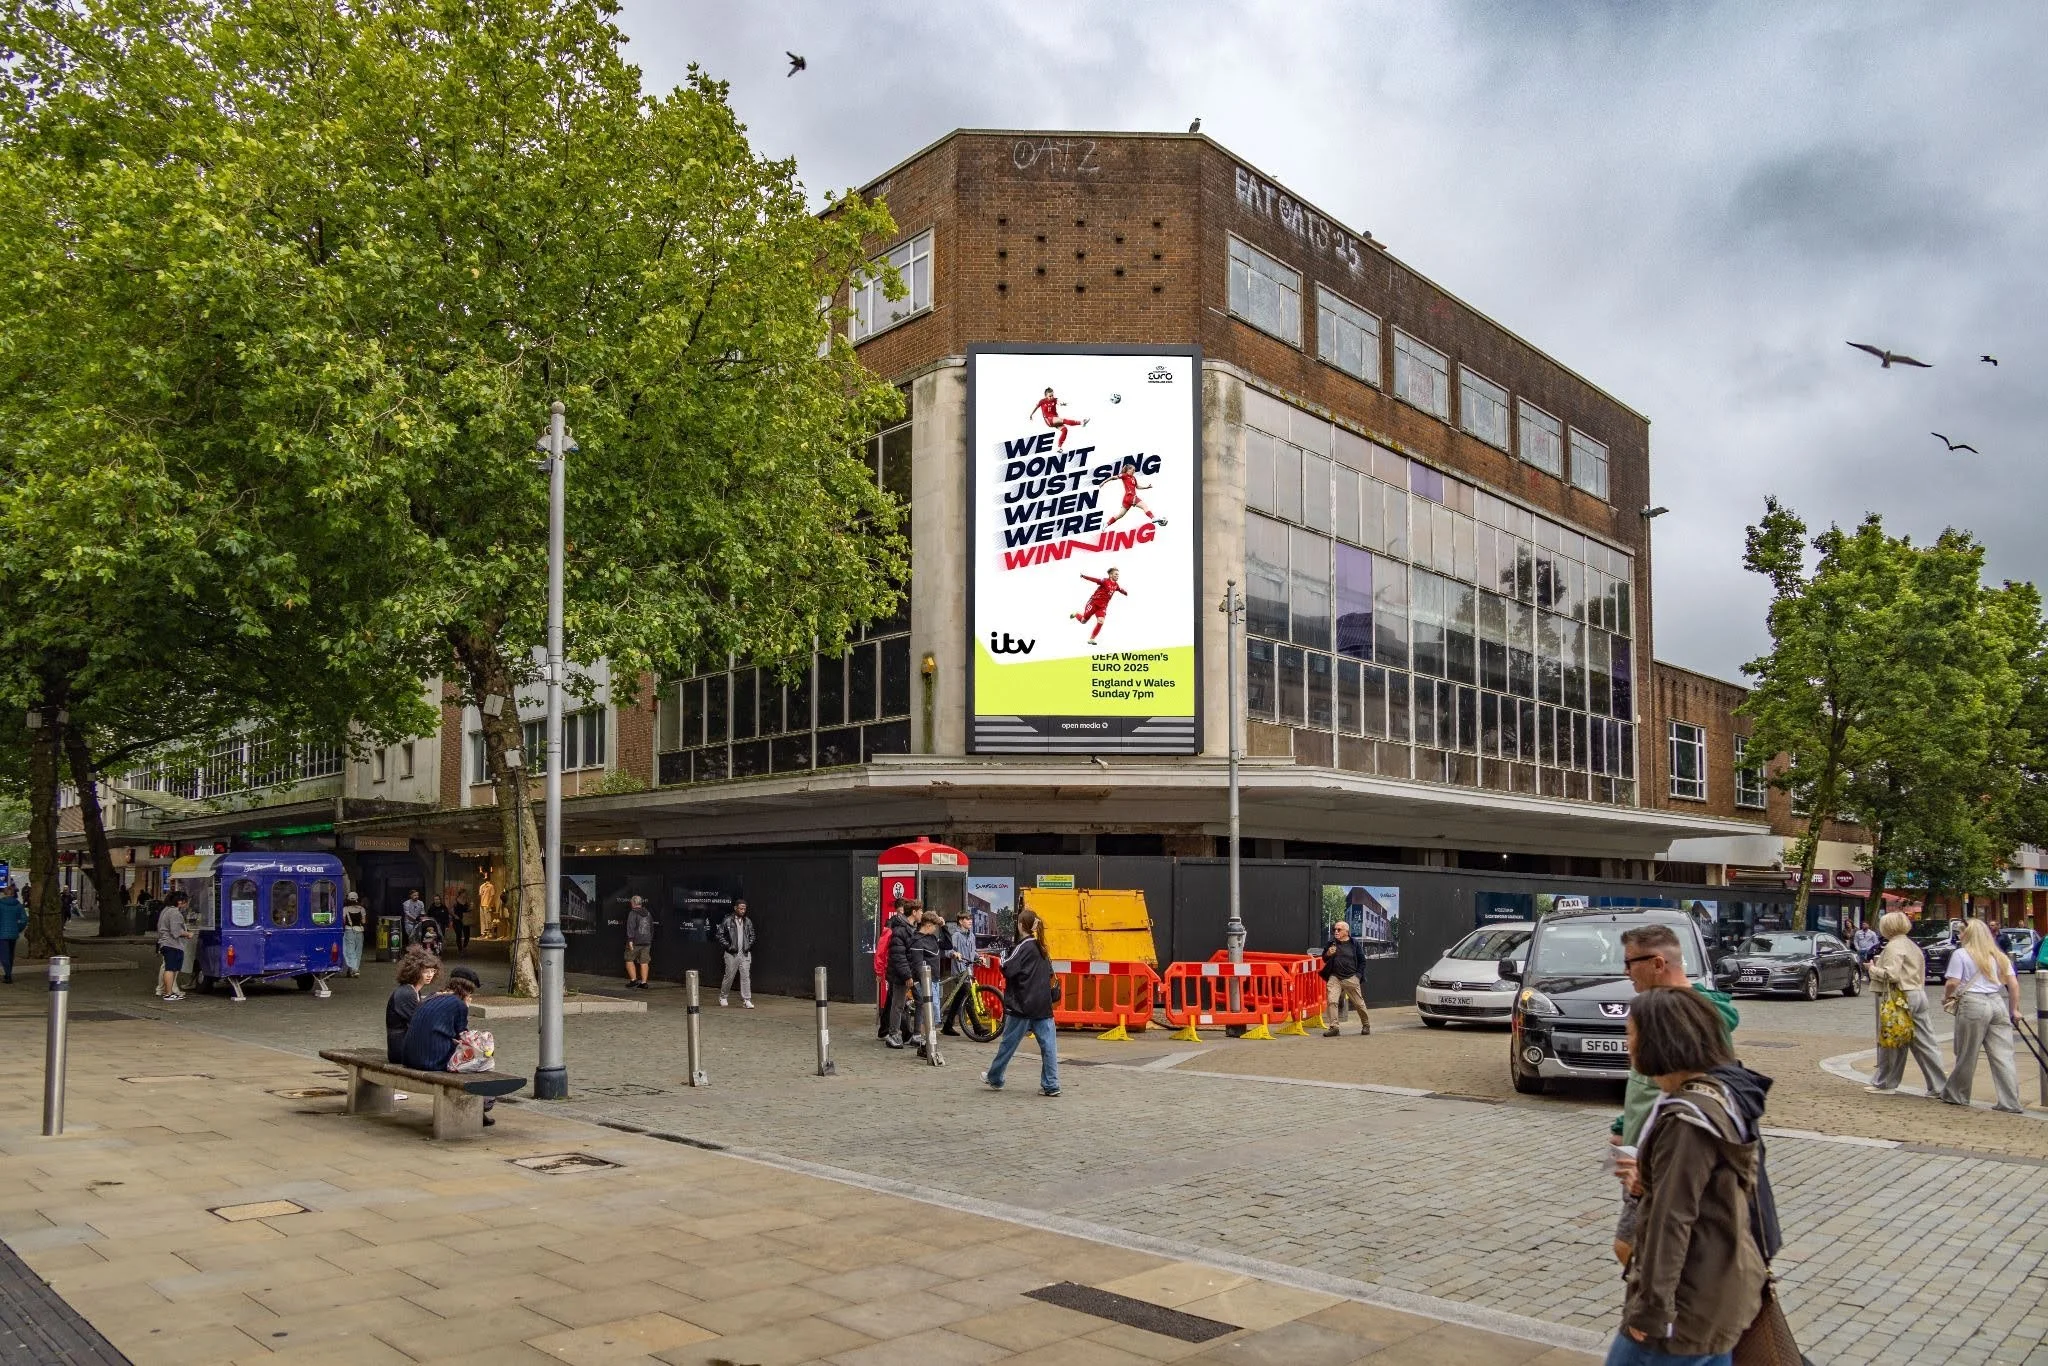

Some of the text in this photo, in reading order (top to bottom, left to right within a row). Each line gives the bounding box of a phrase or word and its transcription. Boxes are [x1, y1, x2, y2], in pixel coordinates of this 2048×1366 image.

[1236, 167, 1277, 219] EAT
[1279, 196, 1329, 249] OATS
[1004, 432, 1055, 459] WE
[1004, 446, 1095, 482] DON'T
[1004, 453, 1161, 503] JUST SING
[1004, 490, 1099, 525] WHEN
[1004, 511, 1103, 548] WE'RE
[1004, 523, 1156, 570] WINNING
[991, 632, 1035, 654] itv
[1121, 652, 1168, 661] Women's
[1092, 663, 1149, 672] EURO 2025
[1092, 678, 1134, 688] England
[1144, 678, 1175, 687] Wales
[1092, 689, 1154, 700] Sunday 7pm
[1586, 1041, 1618, 1051] SF60
